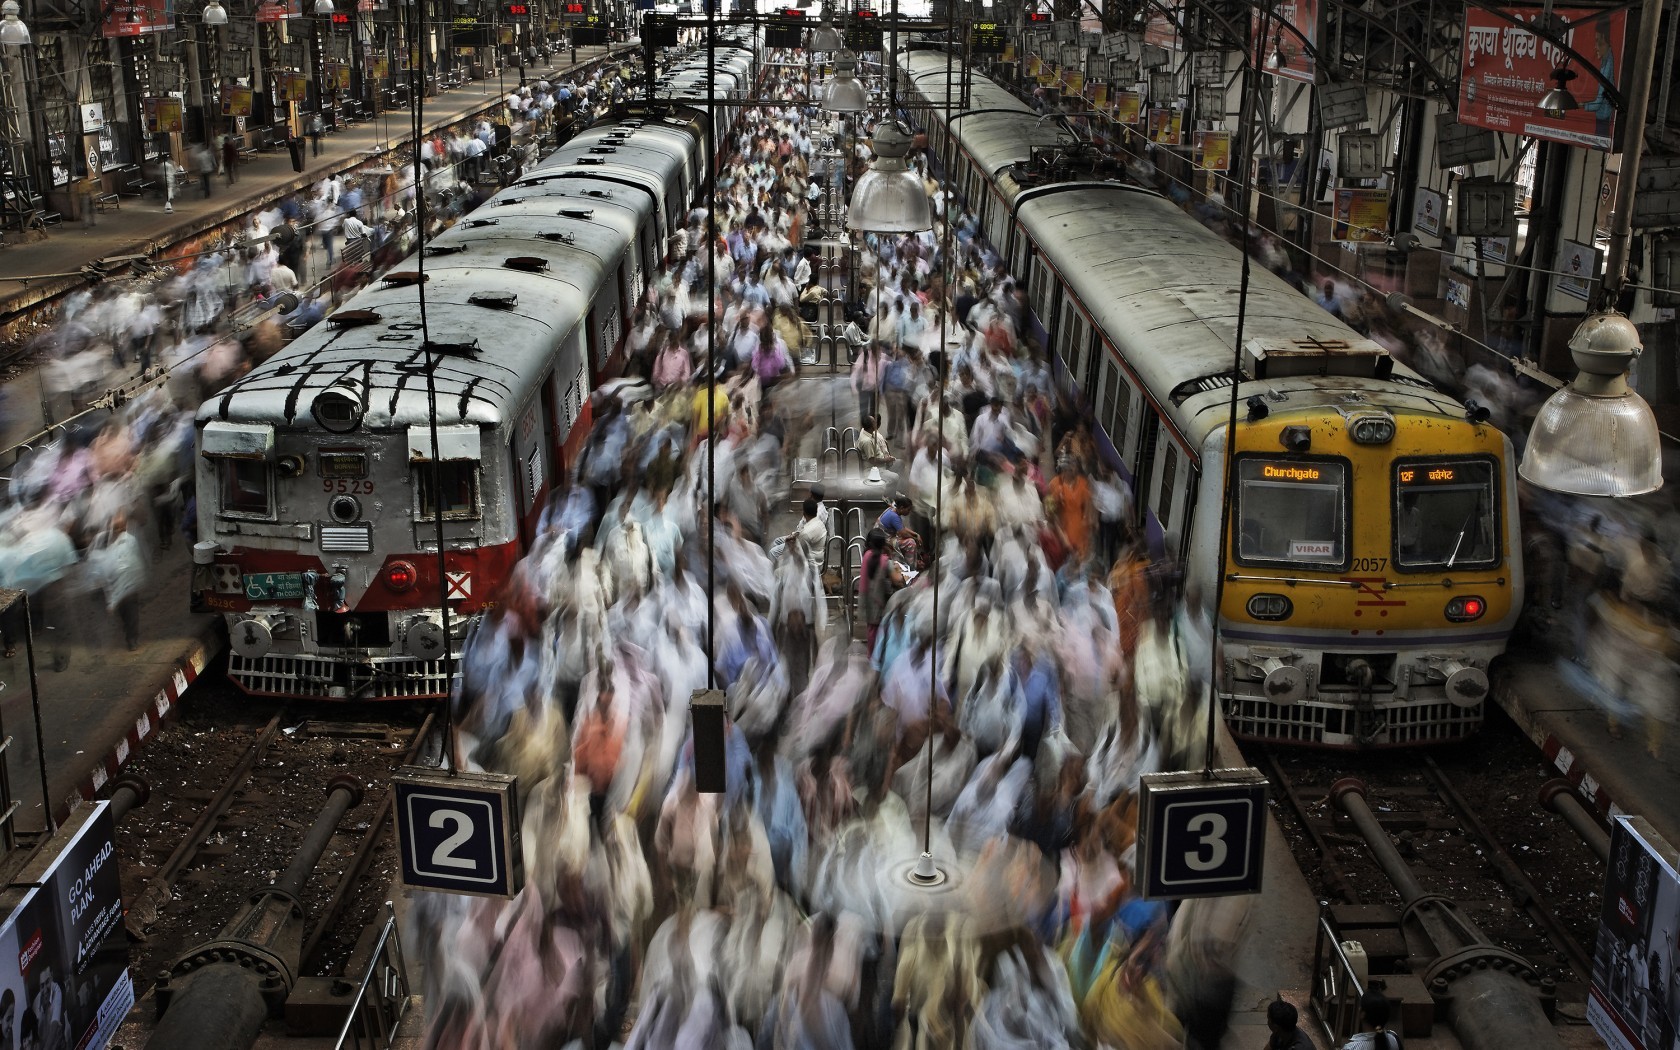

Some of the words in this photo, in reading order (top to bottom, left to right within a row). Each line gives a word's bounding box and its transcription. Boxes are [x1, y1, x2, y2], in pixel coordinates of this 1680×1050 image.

[1468, 26, 1500, 67] कृपया
[1264, 466, 1319, 480] Churchgate
[1401, 471, 1413, 481] 12F
[1429, 470, 1453, 479] चर्चगेट
[323, 480, 374, 494] 9529
[1296, 545, 1330, 553] VIRAR
[1352, 558, 1388, 572] 2057
[266, 575, 274, 585] 4
[429, 809, 477, 869] 2
[1184, 813, 1228, 871] 3
[69, 878, 83, 904] GO
[85, 841, 114, 885] AHEAD.
[71, 887, 95, 925] PLAN.
